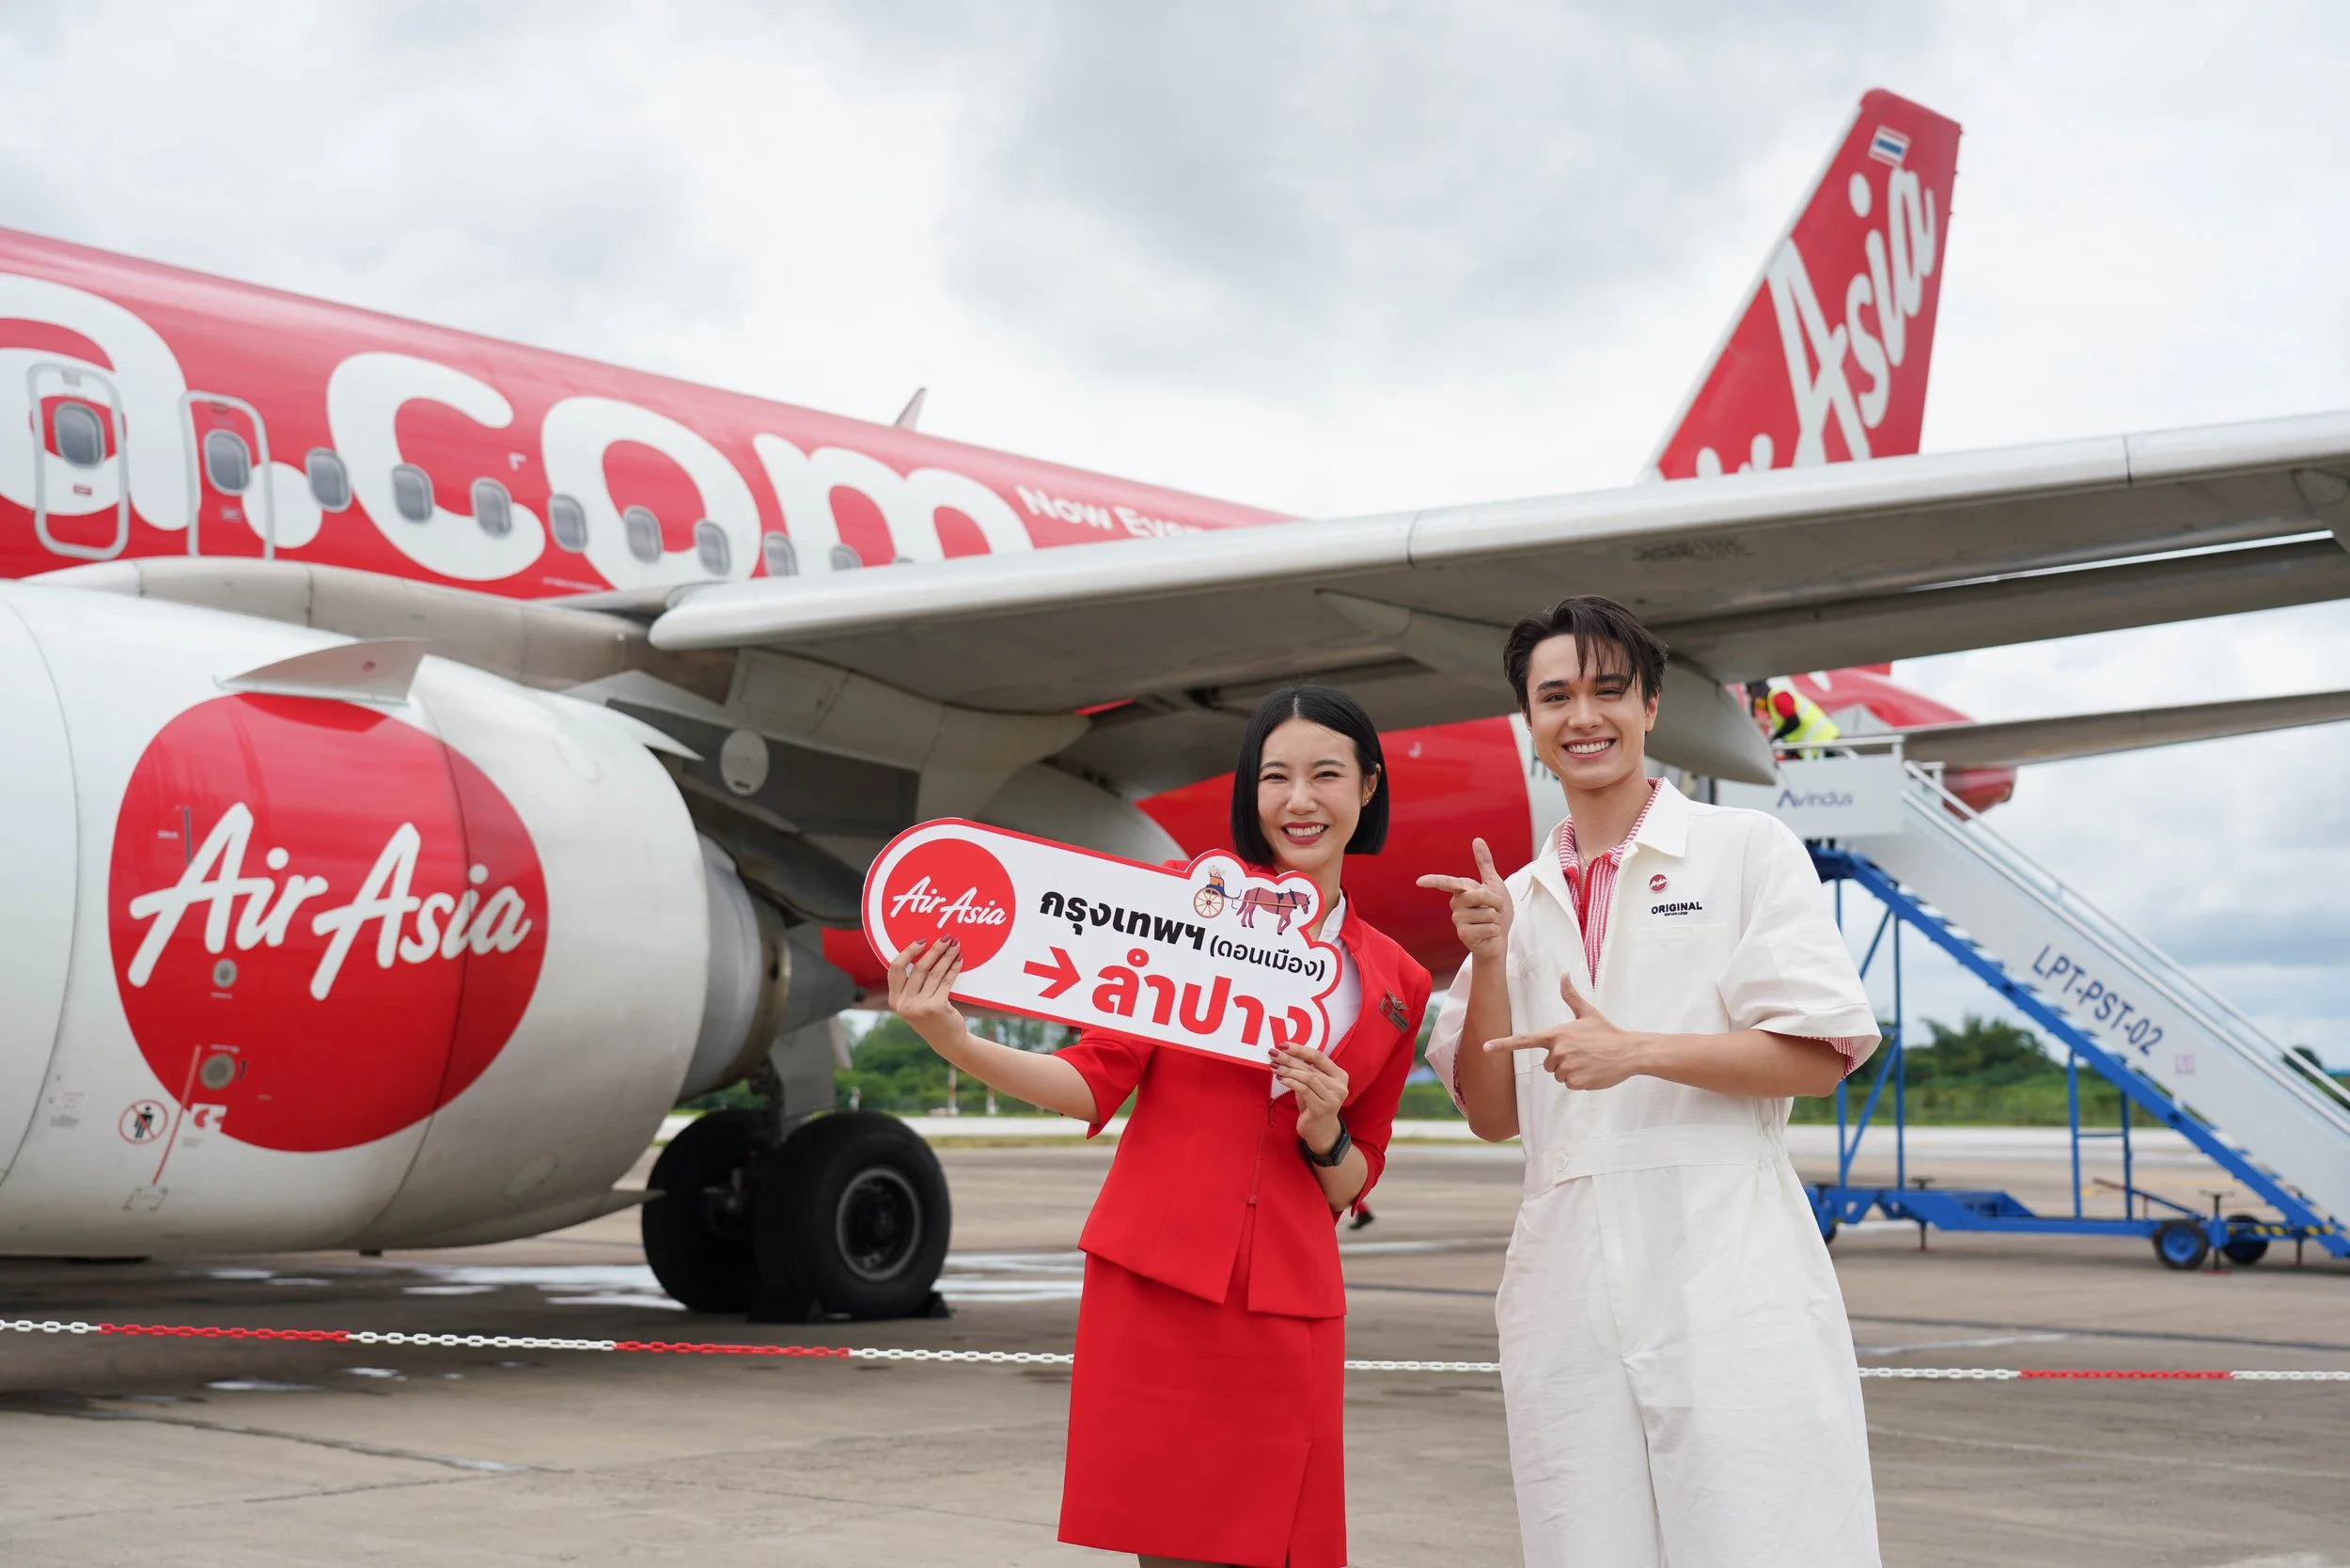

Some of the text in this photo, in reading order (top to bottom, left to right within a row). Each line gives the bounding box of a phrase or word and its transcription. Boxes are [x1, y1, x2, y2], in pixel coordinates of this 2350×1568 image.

[1015, 485, 1114, 531] Now
[1039, 890, 1325, 981] กรุงเทพฯ (ดอนเมือง)
[1651, 902, 1702, 915] ORIGINAL
[1091, 948, 1313, 1050] ลำปาง
[2032, 943, 2164, 1057] LPT-PST-02
